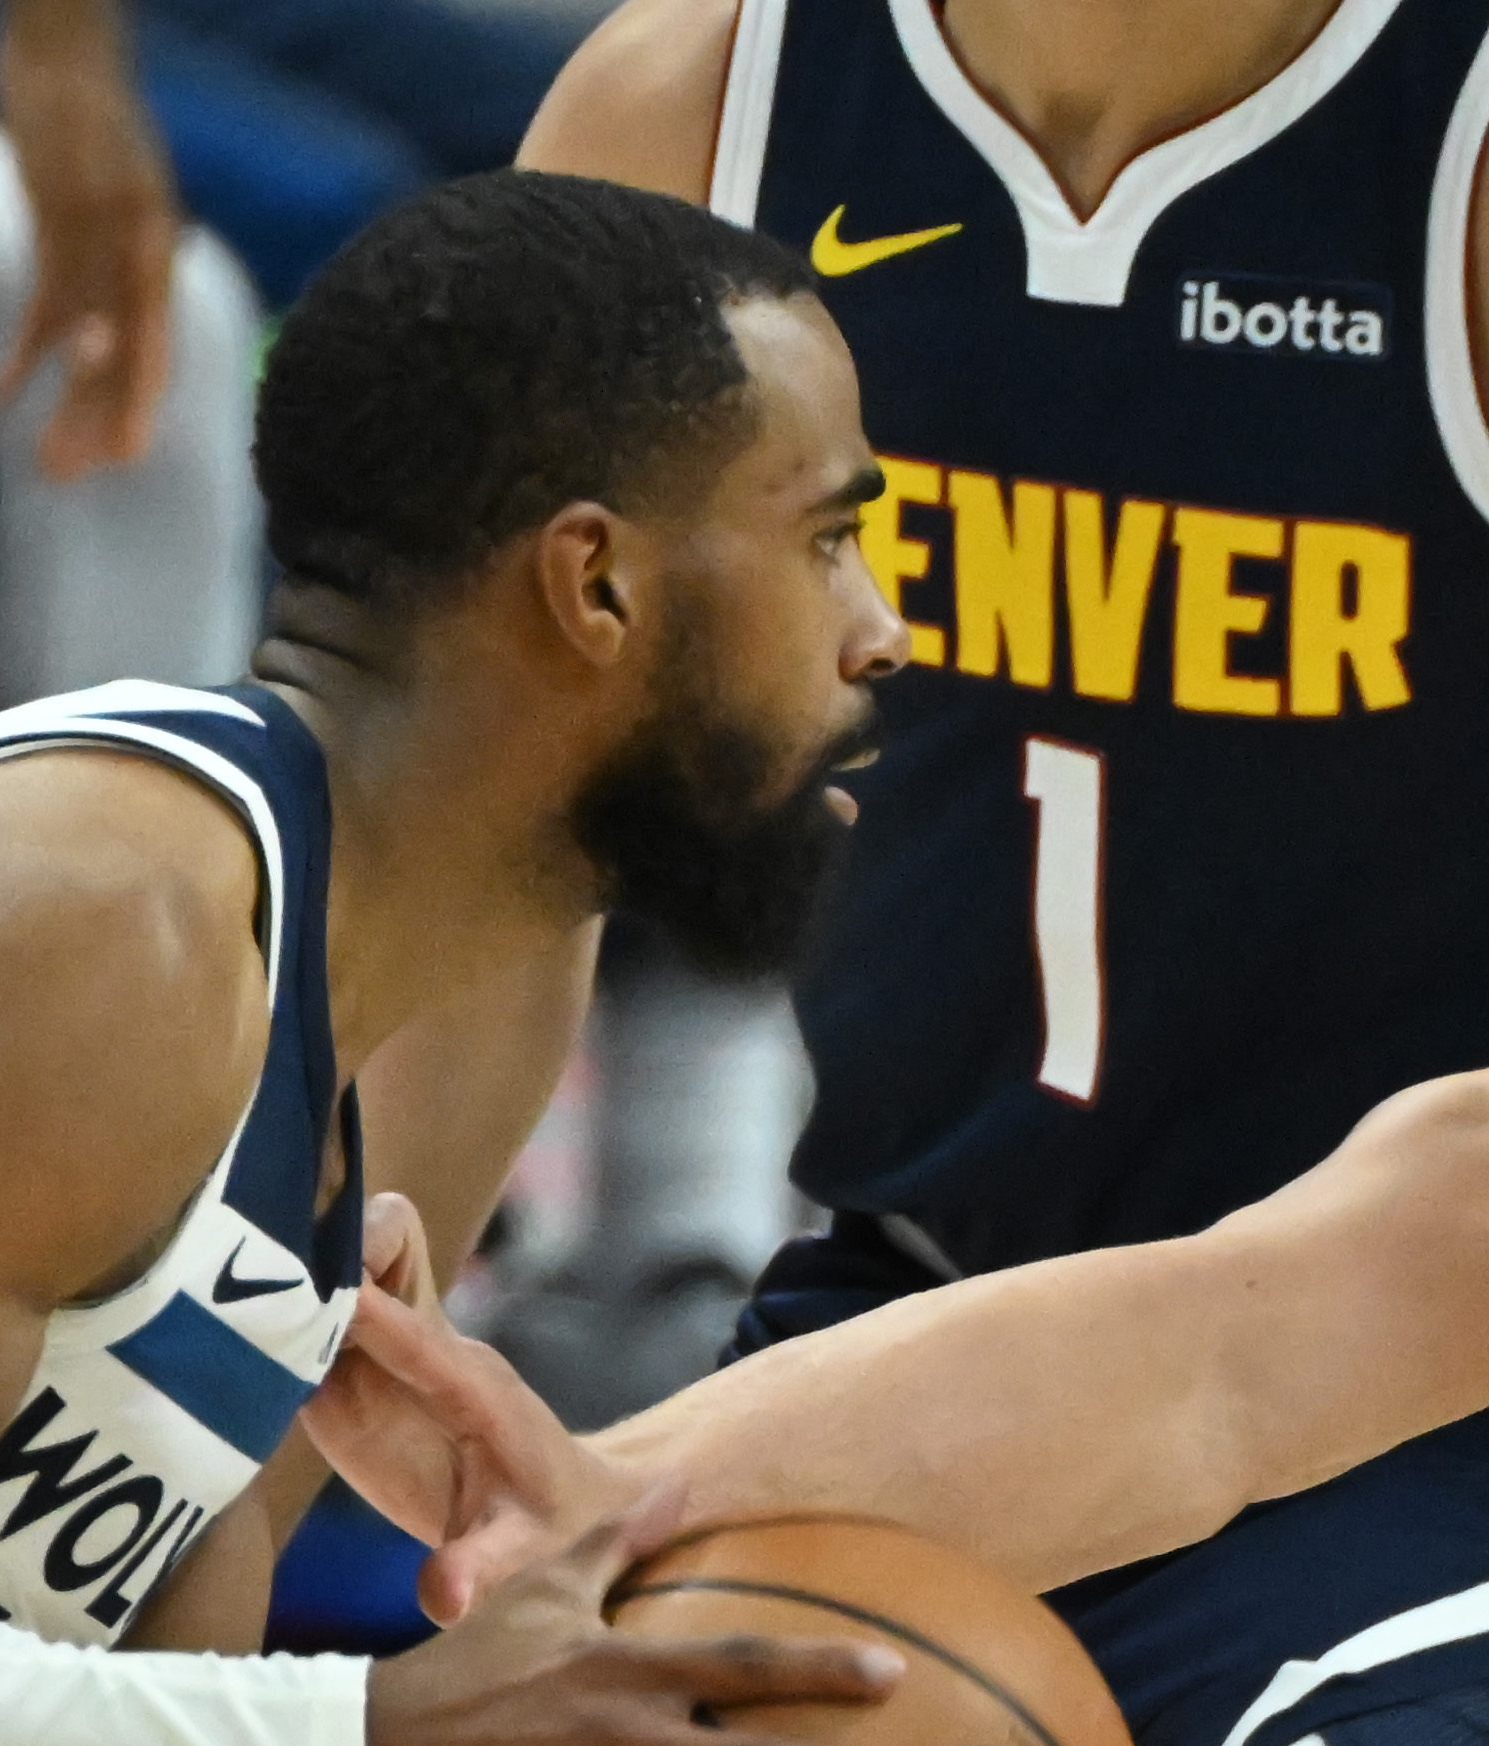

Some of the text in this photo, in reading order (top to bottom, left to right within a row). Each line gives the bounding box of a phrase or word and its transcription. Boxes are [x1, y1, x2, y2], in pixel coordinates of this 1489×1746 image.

[1179, 283, 1384, 356] ibotta
[857, 454, 1413, 718] ENVER
[1022, 734, 1105, 1107] 1
